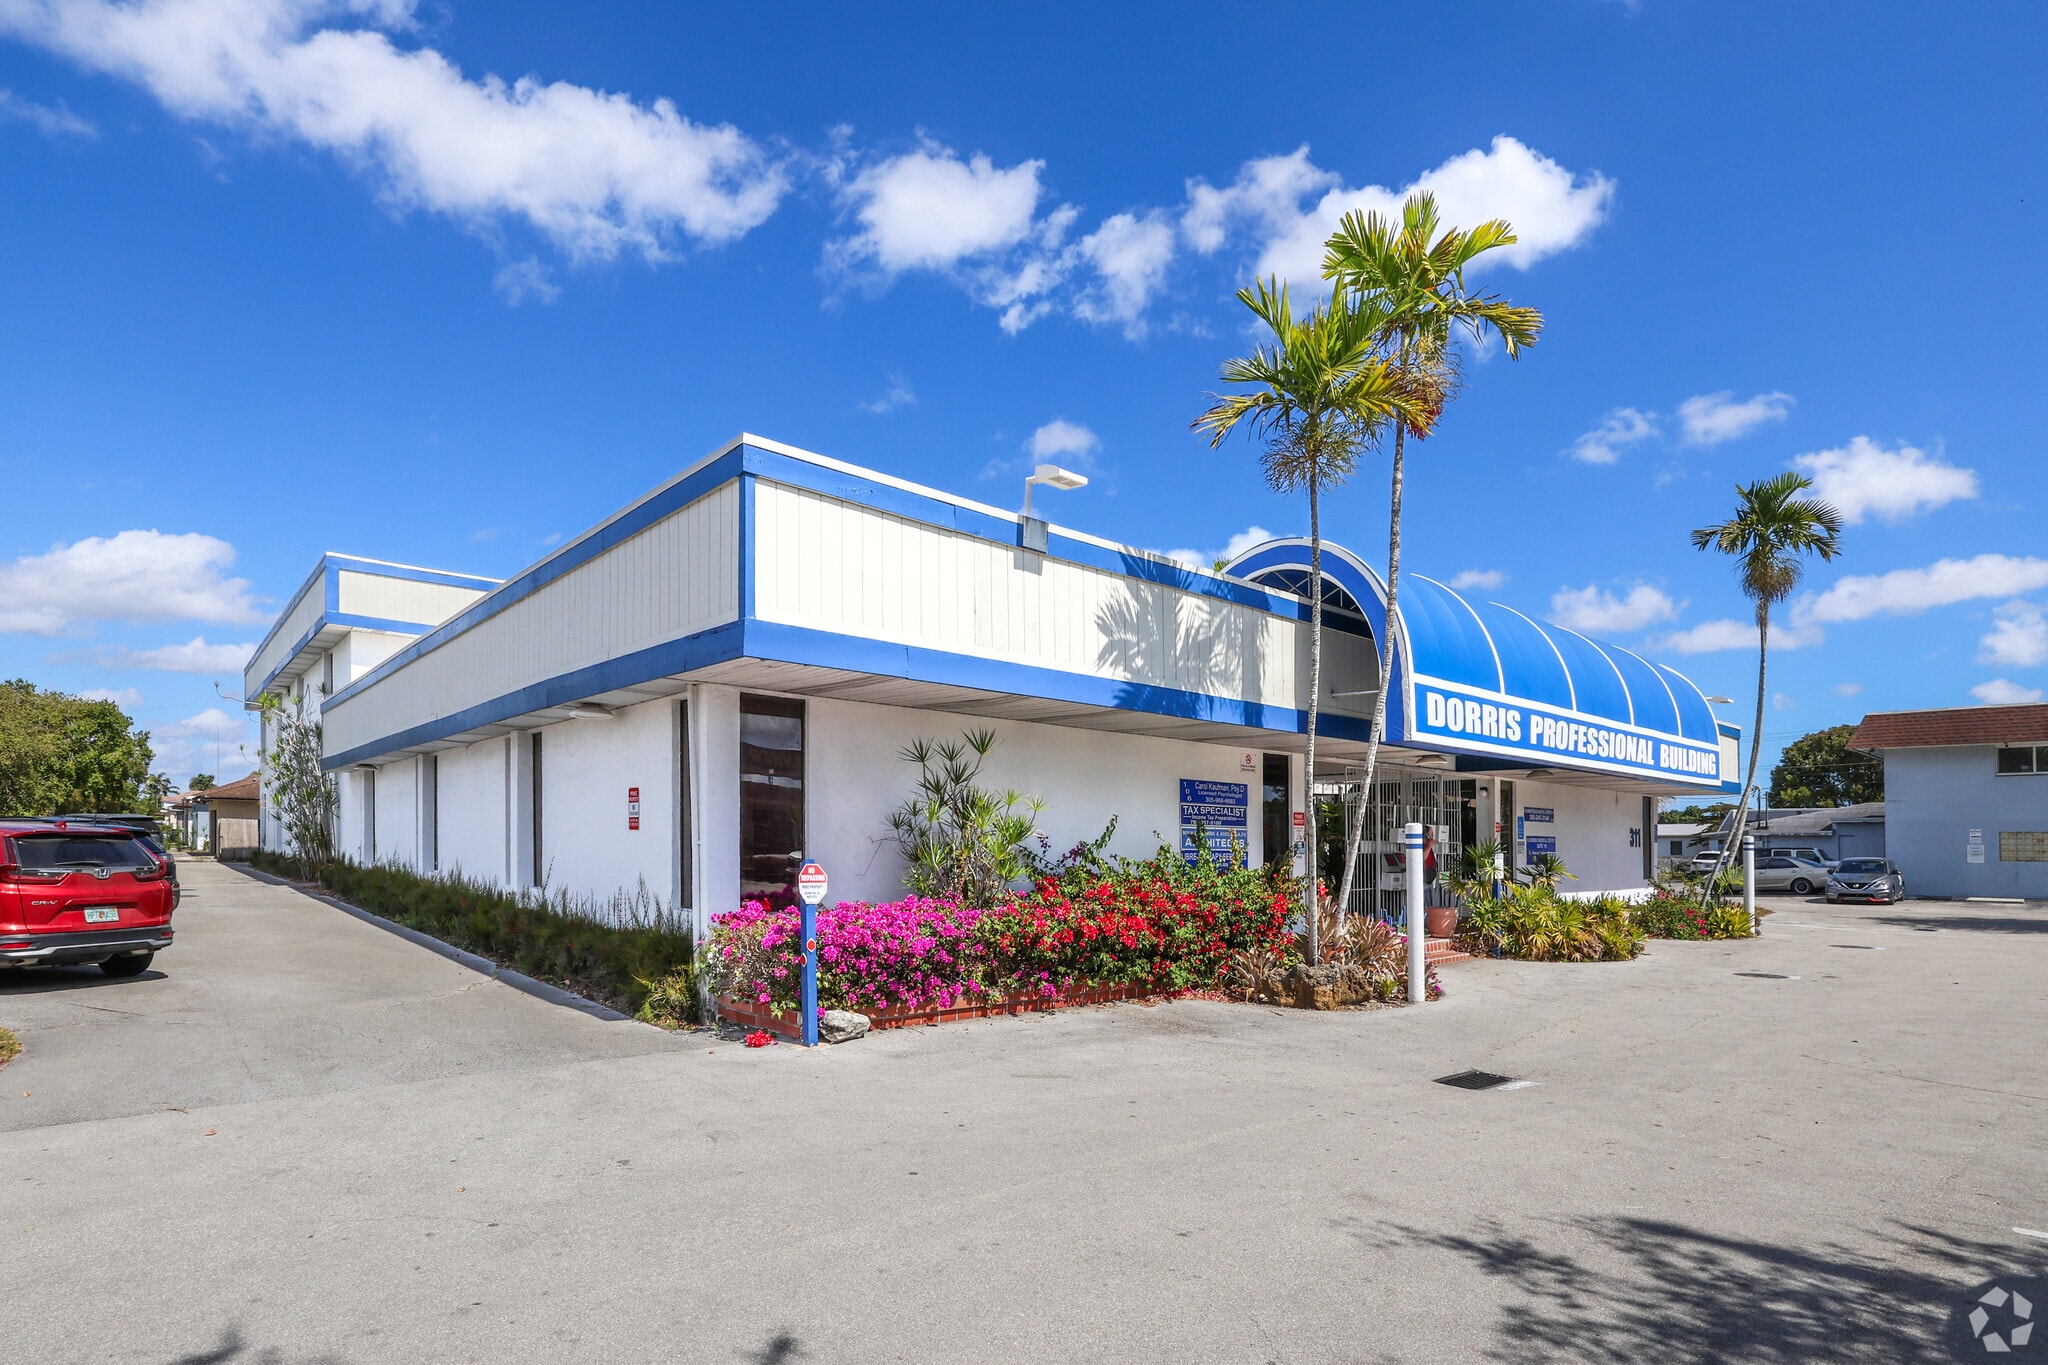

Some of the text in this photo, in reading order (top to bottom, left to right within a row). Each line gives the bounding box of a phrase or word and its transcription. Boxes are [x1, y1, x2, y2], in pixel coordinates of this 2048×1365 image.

[1426, 691, 1717, 776] DORRIS PROFESSIONAL BUILDING
[1194, 781, 1208, 790] Carol
[1217, 791, 1243, 799] Psychologist
[1182, 805, 1245, 818] TAX SPECIALIST
[1629, 827, 1641, 848] 311
